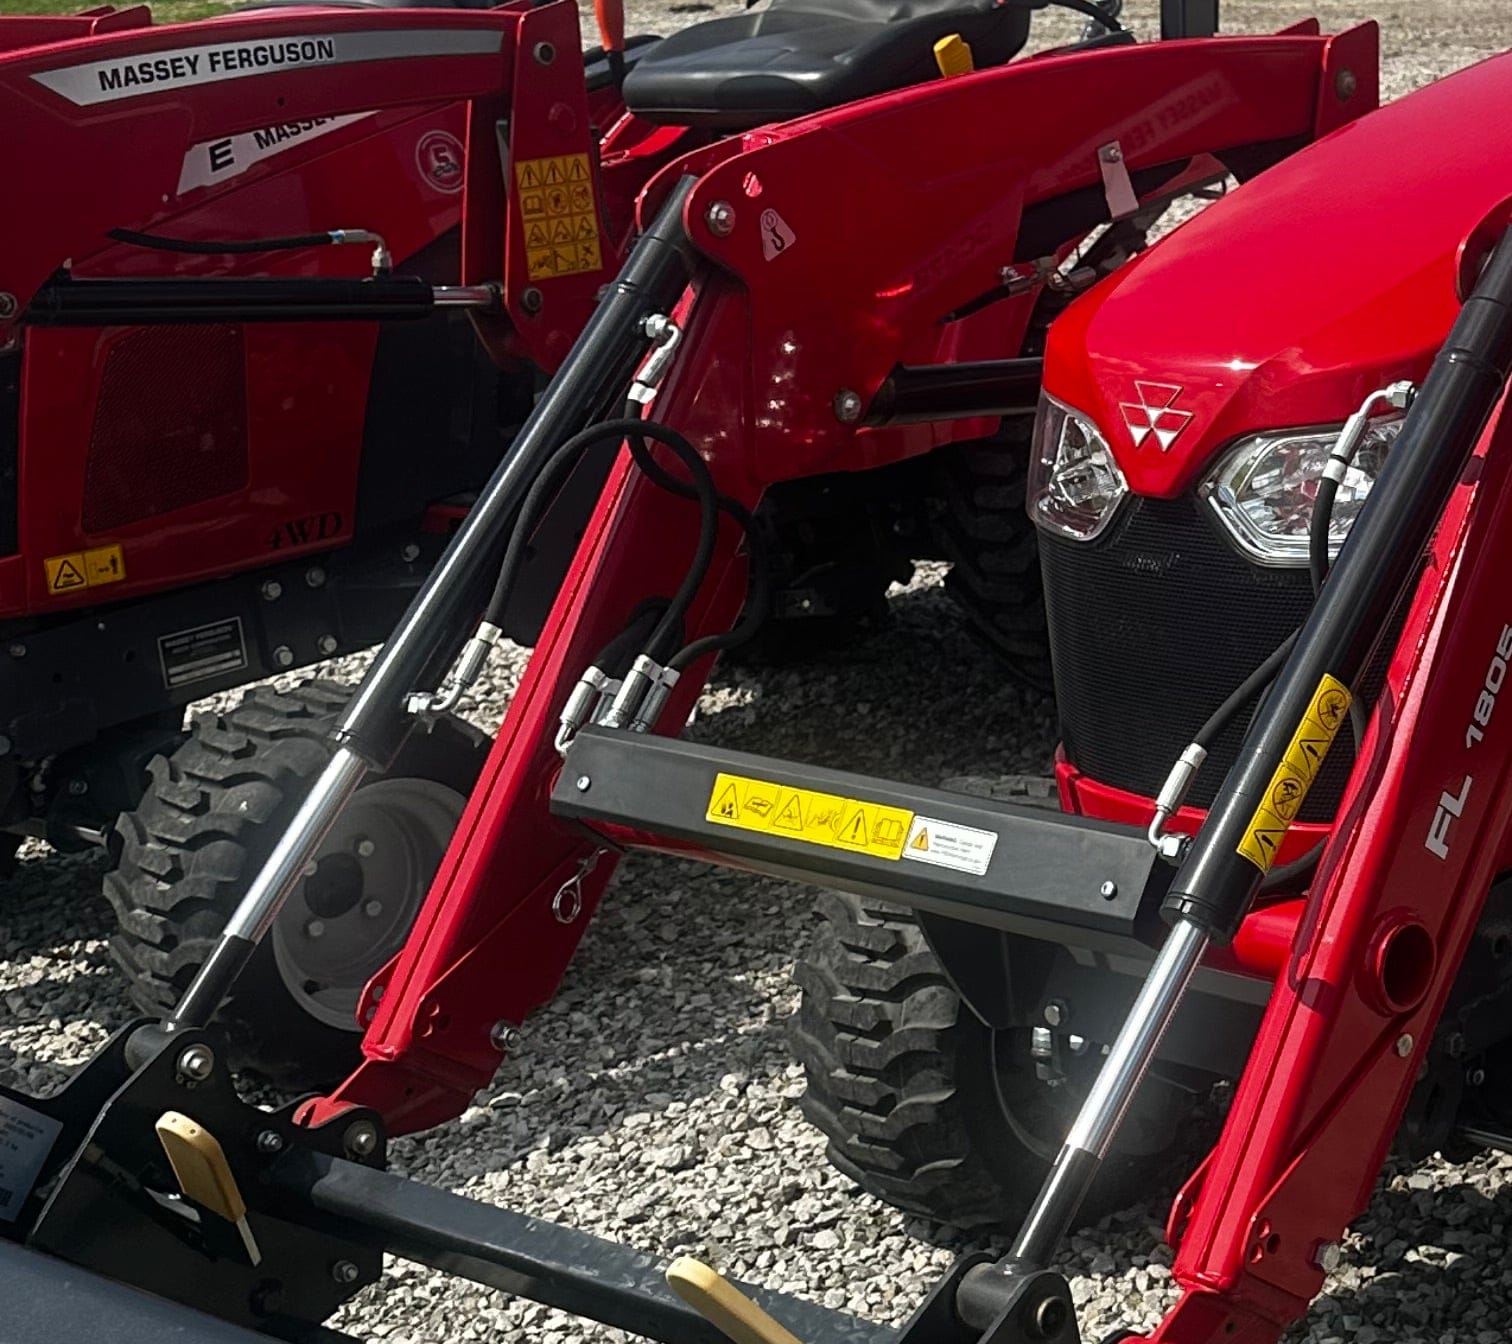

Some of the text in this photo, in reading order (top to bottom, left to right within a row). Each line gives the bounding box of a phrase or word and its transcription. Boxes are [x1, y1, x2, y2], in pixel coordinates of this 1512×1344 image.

[98, 39, 335, 92] MASSEY FERGUSON
[208, 138, 236, 173] E
[262, 511, 344, 551] 4WD
[1424, 774, 1473, 860] FL
